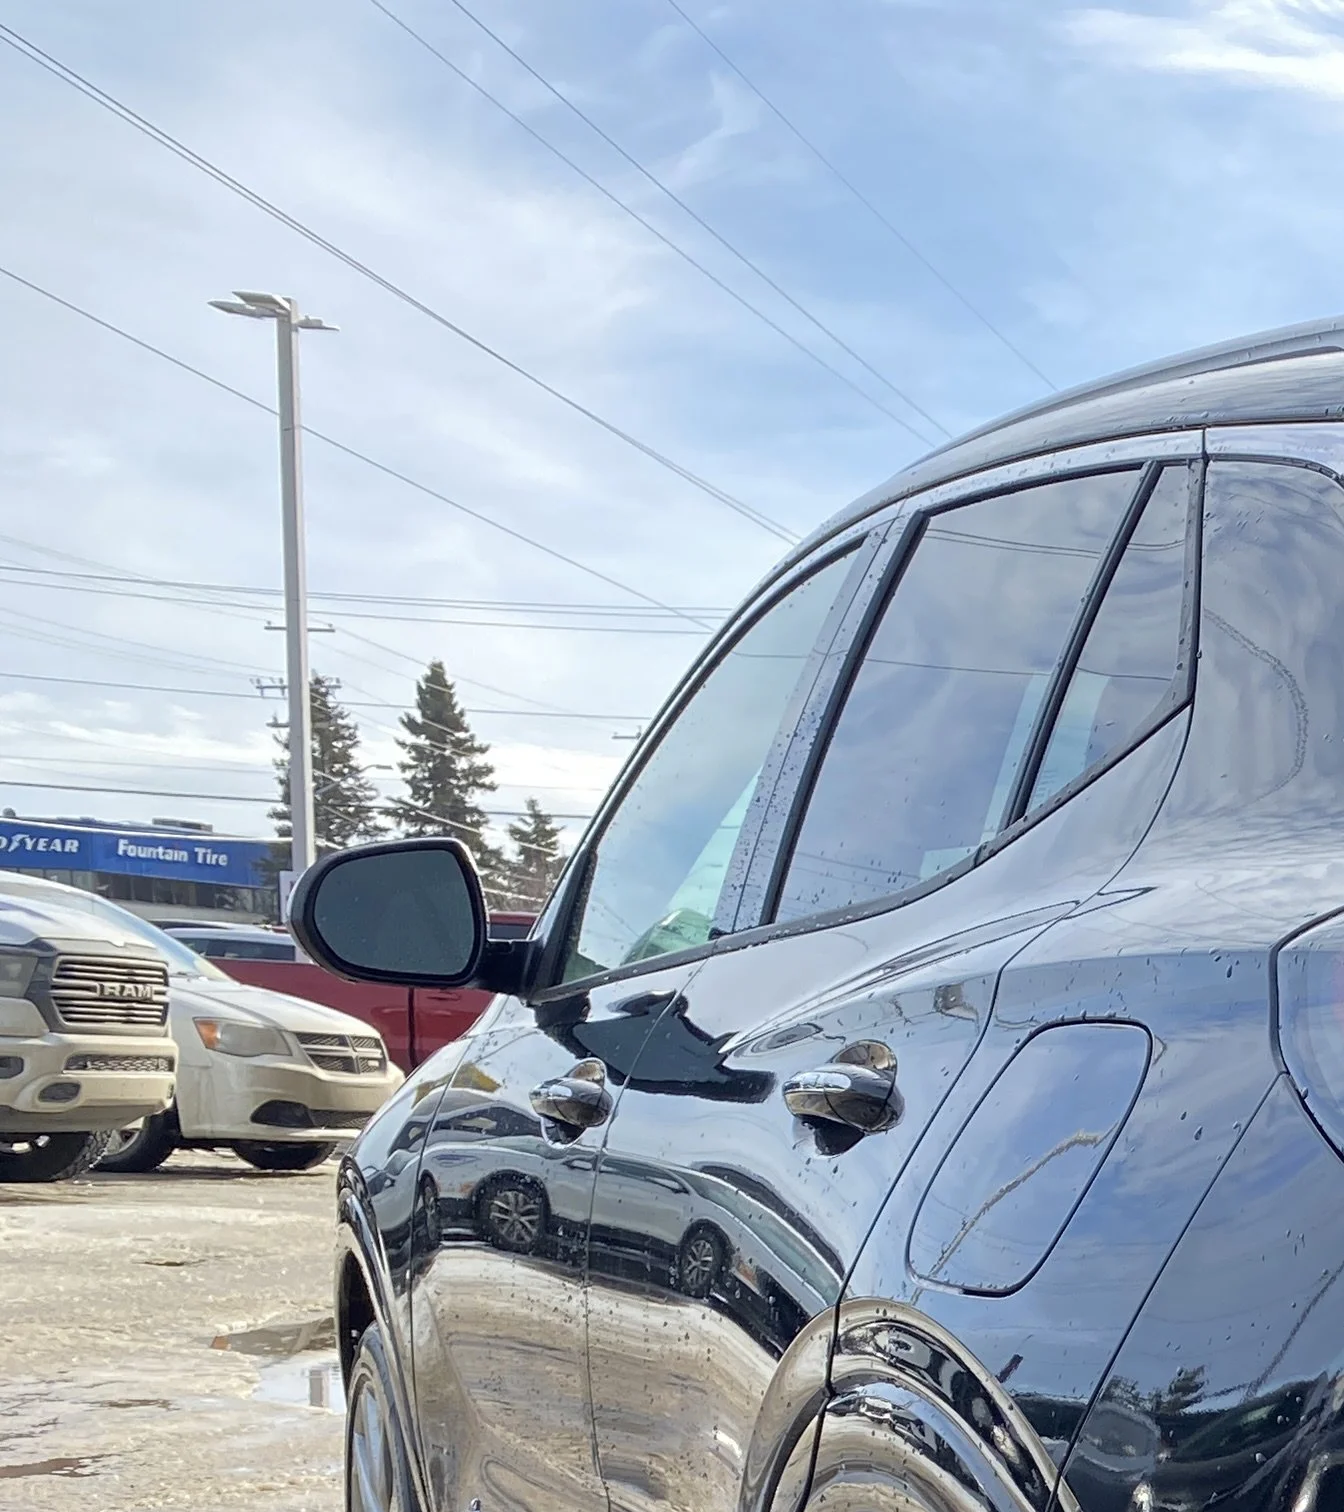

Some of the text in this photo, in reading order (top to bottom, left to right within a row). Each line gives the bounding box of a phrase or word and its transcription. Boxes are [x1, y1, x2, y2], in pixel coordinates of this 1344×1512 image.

[117, 838, 228, 867] Fountain Tire
[103, 984, 152, 998] RAM
